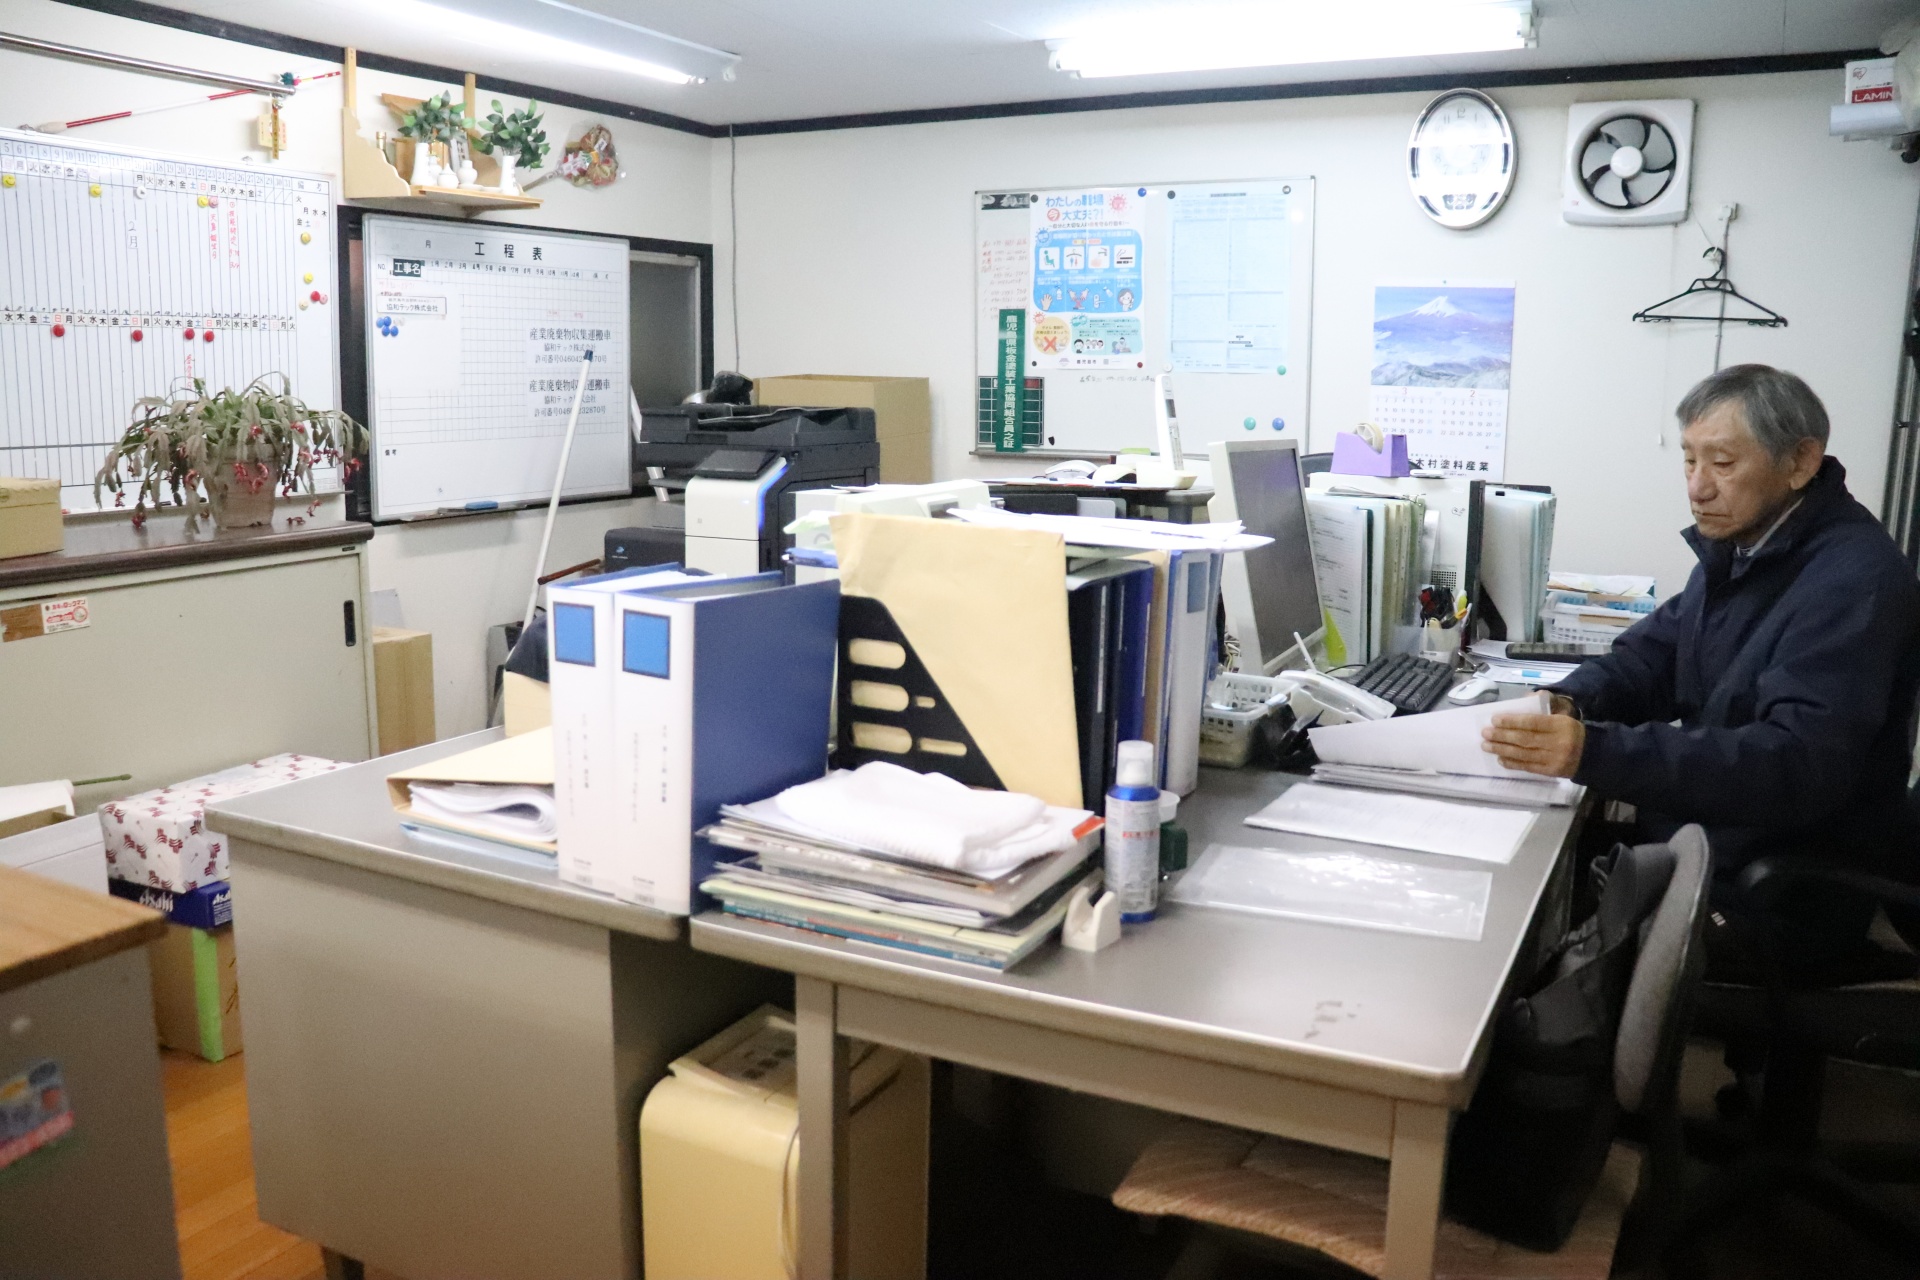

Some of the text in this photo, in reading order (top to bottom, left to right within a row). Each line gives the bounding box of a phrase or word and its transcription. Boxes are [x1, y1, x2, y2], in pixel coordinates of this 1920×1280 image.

[4, 143, 10, 152] 5
[17, 144, 22, 154] 6
[30, 145, 35, 155] 7
[43, 148, 48, 157] 8
[55, 148, 60, 158] 9
[65, 151, 73, 160] 10
[77, 152, 86, 162] 11
[88, 154, 97, 163] 12
[65, 168, 75, 178] 金
[136, 174, 143, 183] 月
[145, 175, 155, 184] 火
[157, 177, 165, 186] 水
[168, 179, 176, 188] 木
[179, 180, 186, 189] 金
[189, 182, 197, 190] 土
[199, 182, 206, 191] 日
[210, 184, 216, 192] 月
[220, 186, 227, 194] 火
[229, 187, 236, 195] 水
[239, 188, 246, 196] 木
[248, 189, 255, 197] 金
[295, 195, 302, 203] 火
[303, 206, 309, 214] 月
[296, 218, 303, 226] 金
[425, 240, 543, 261] 月 工程表
[394, 262, 421, 275] 工事名
[386, 303, 438, 312] 協和テック株式会社
[4, 312, 13, 322] 水
[16, 313, 25, 321] 木
[29, 314, 38, 323] 金
[42, 315, 50, 323] 土
[55, 314, 61, 323] 日
[65, 315, 73, 323] 月
[77, 315, 85, 323] 火
[99, 317, 107, 325] 木
[111, 316, 120, 326] 金
[123, 317, 130, 325] 土
[132, 317, 138, 325] 日
[143, 318, 150, 327] 月
[154, 317, 162, 325] 火
[164, 319, 172, 327] 水
[174, 319, 182, 327] 木
[186, 319, 194, 327] 金
[206, 319, 212, 327] 日
[215, 319, 222, 327] 月
[224, 319, 231, 327] 火
[233, 320, 240, 328] 水
[252, 320, 258, 328] 金
[280, 321, 287, 329] 月
[289, 322, 296, 330] 火
[530, 328, 611, 341] 産業廃棄物収集運搬車
[529, 378, 611, 392] 産業廃棄物収運搬車
[1003, 315, 1018, 449] 鹿児島県板金塗装工業協同組合員之証
[1402, 387, 1476, 398] 3 2
